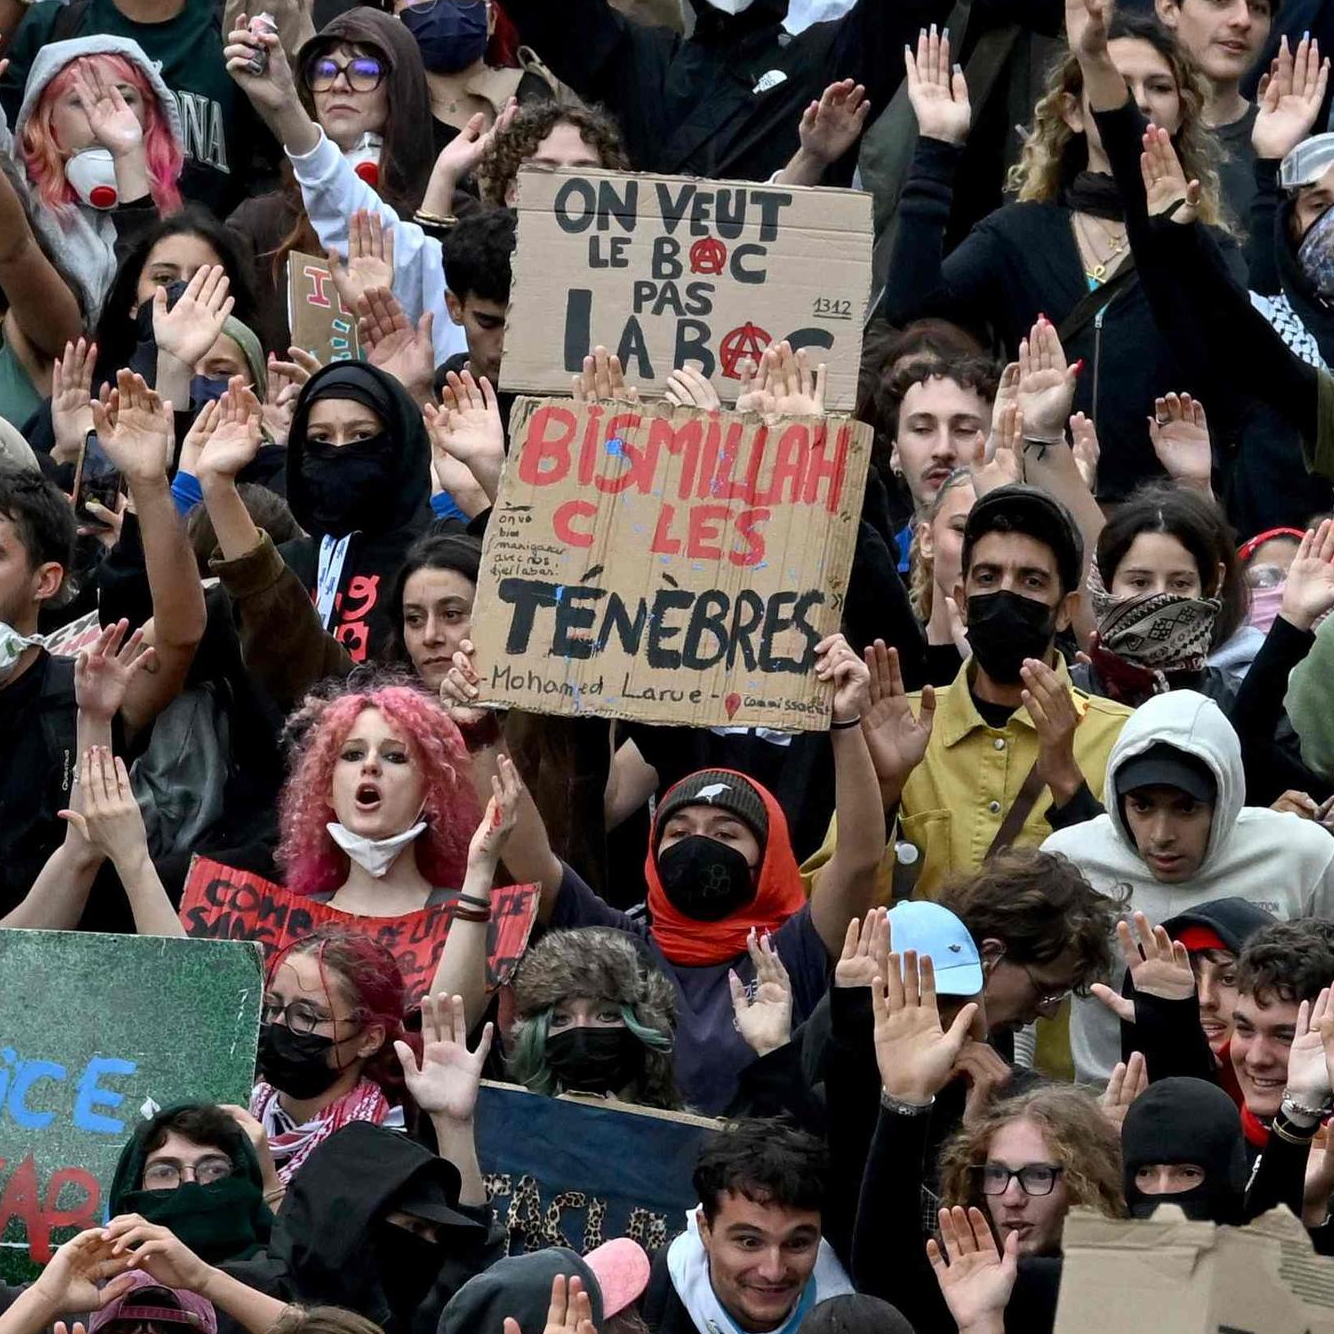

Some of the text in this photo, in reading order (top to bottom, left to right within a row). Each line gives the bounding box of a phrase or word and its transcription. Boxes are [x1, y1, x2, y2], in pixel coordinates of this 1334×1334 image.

[554, 177, 792, 242] ON VEUT
[588, 235, 767, 285] LE BAC
[633, 280, 715, 317] PAS
[812, 297, 852, 316] 1312
[518, 405, 852, 516] BISMILLAH
[551, 499, 771, 566] C LES
[498, 565, 827, 675] TÉNÈBRES
